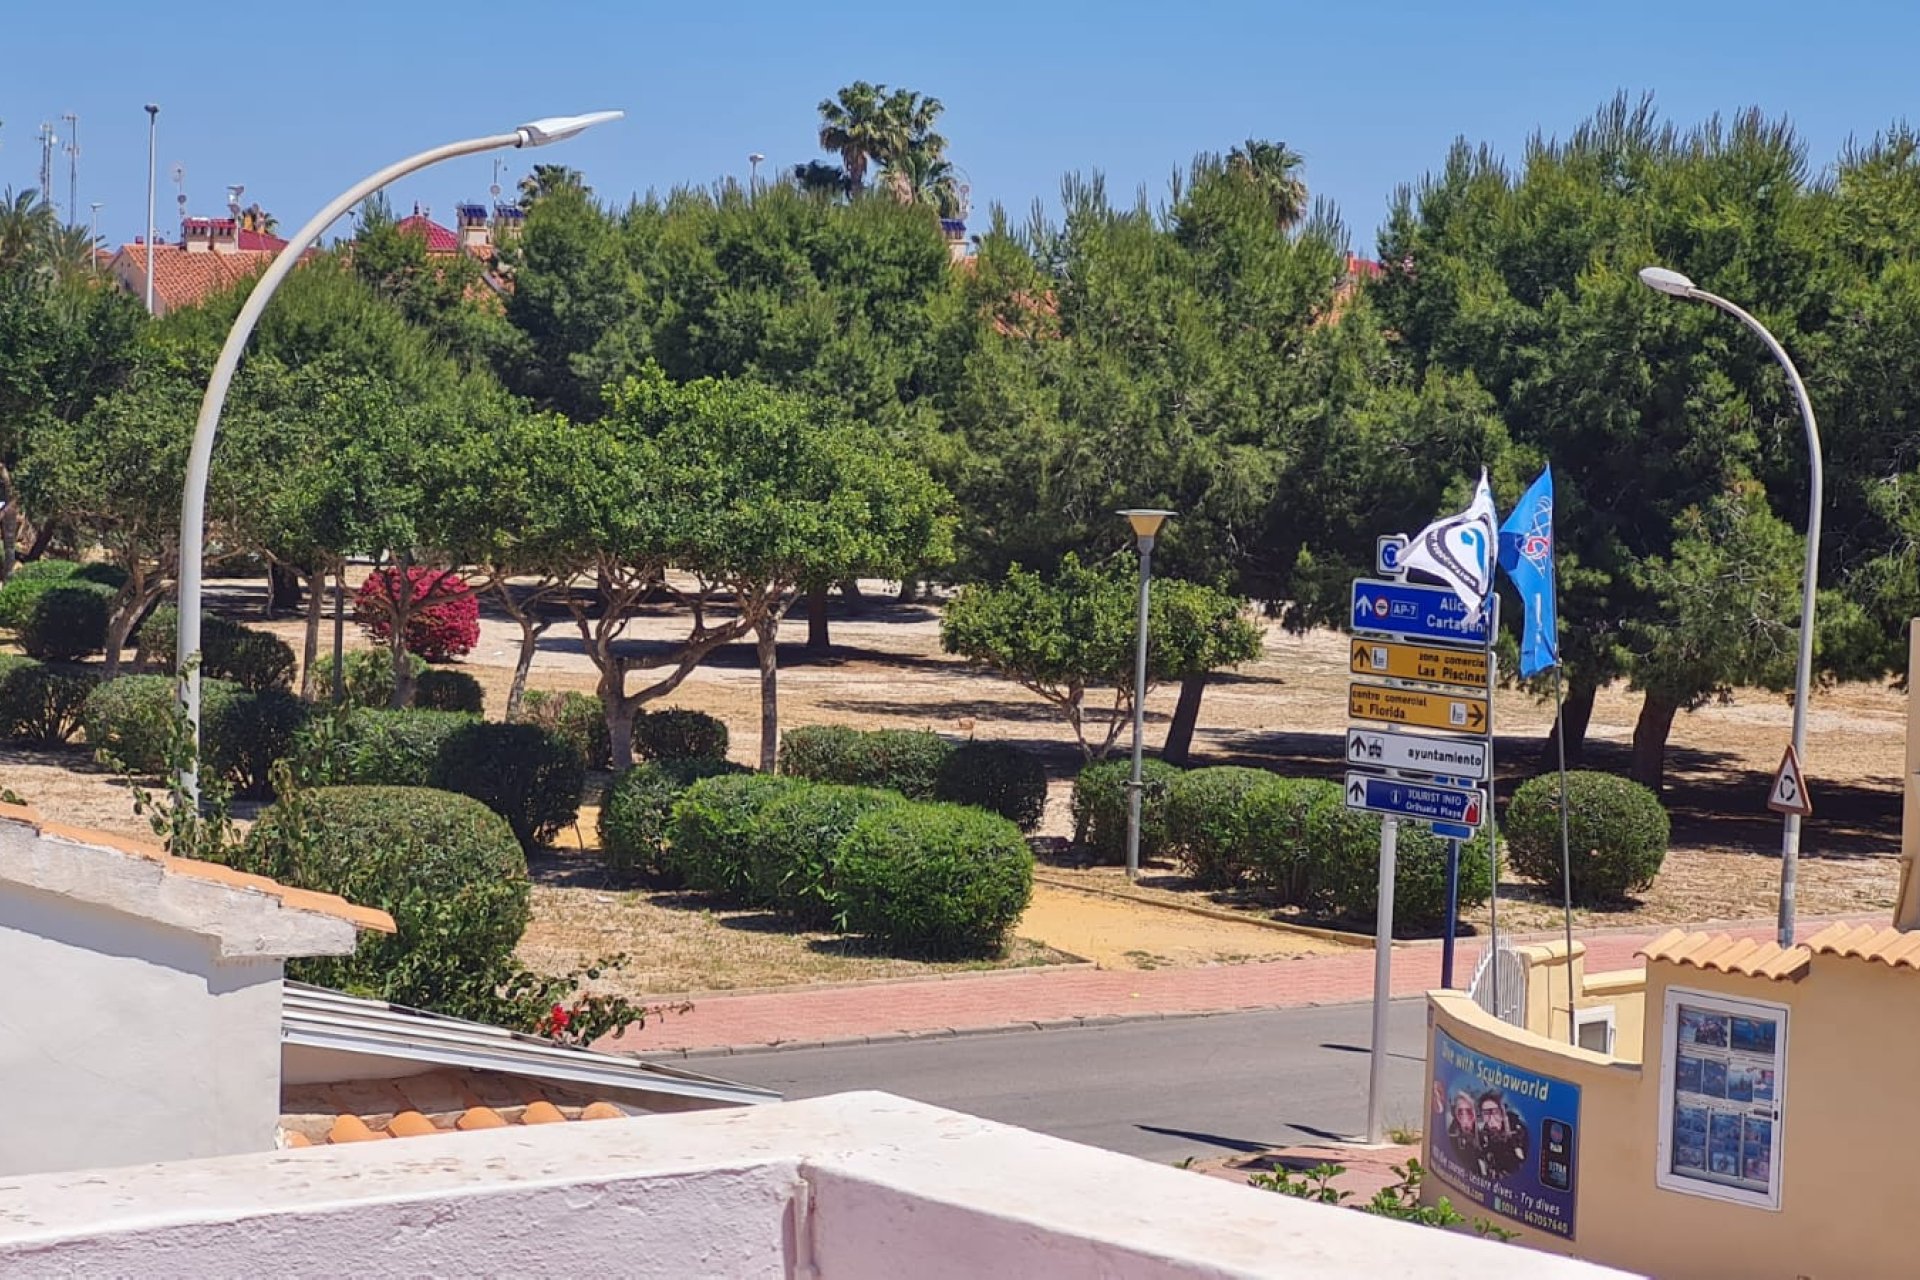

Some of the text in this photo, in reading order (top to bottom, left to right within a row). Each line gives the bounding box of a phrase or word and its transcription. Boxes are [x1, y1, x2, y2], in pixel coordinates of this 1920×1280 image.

[1393, 603, 1416, 615] AP-7
[1419, 653, 1439, 662] zona
[1418, 664, 1435, 677] Las
[1443, 667, 1486, 683] Piscinas
[1352, 690, 1381, 701] centro
[1385, 694, 1427, 706] comercial
[1352, 701, 1363, 713] La
[1369, 703, 1405, 718] Florida
[1408, 748, 1482, 766] ayuntamiento
[1408, 788, 1462, 806] TOURIST INFO
[1456, 1055, 1475, 1074] with
[1476, 1060, 1549, 1101] Scubaworld
[1492, 1181, 1513, 1199] dives
[1521, 1192, 1535, 1209] Try
[1535, 1198, 1561, 1216] dives
